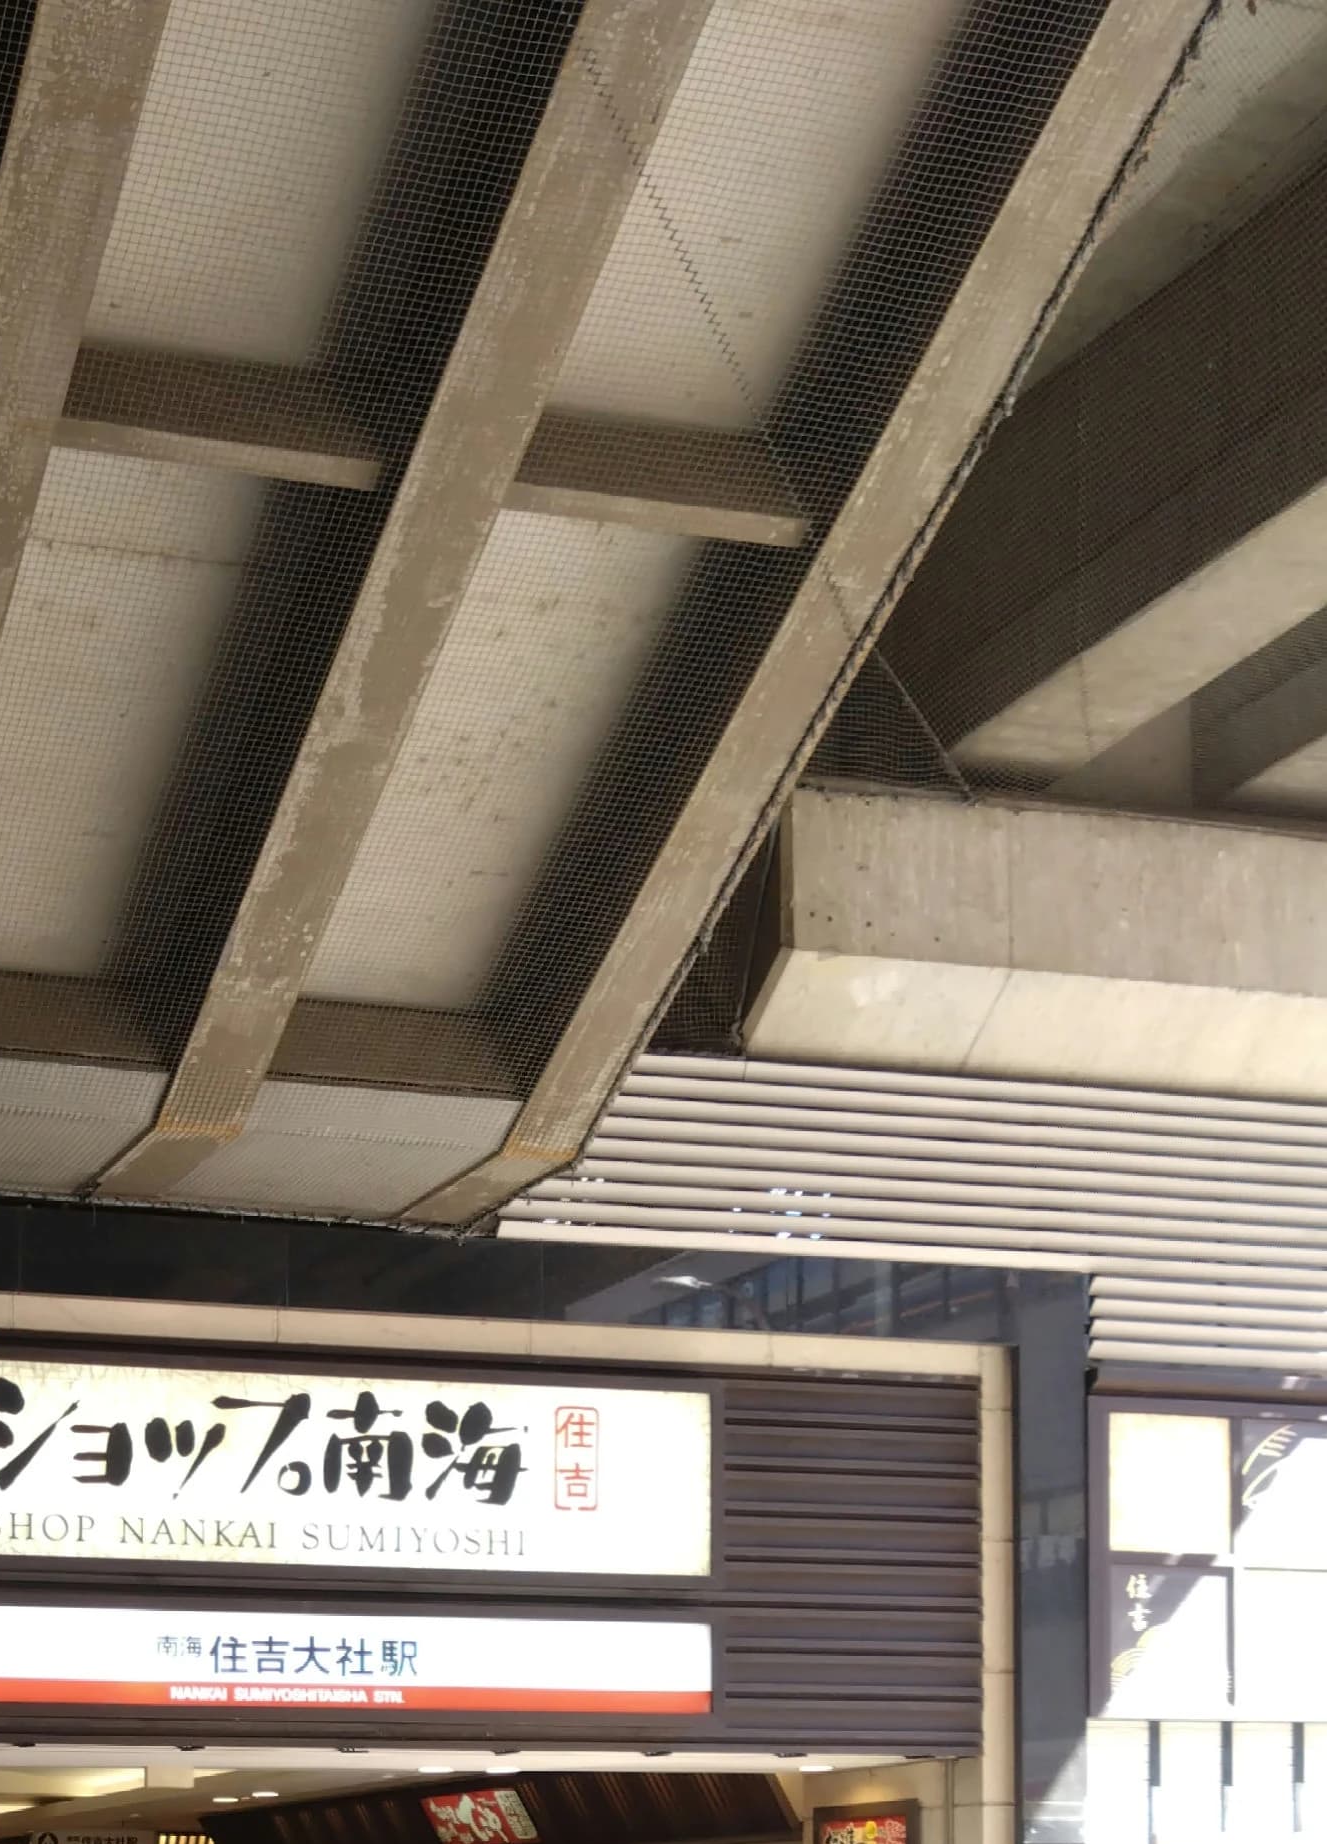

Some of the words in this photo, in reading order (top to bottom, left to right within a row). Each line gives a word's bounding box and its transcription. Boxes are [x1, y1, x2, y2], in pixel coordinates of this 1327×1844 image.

[556, 1413, 595, 1498] 住吉
[120, 1517, 276, 1548] NANKAI
[301, 1522, 526, 1556] SUMIYOSHI
[157, 1635, 202, 1658] 南海
[210, 1636, 418, 1676] 住吉大社駅
[170, 1686, 227, 1701] NANKAI
